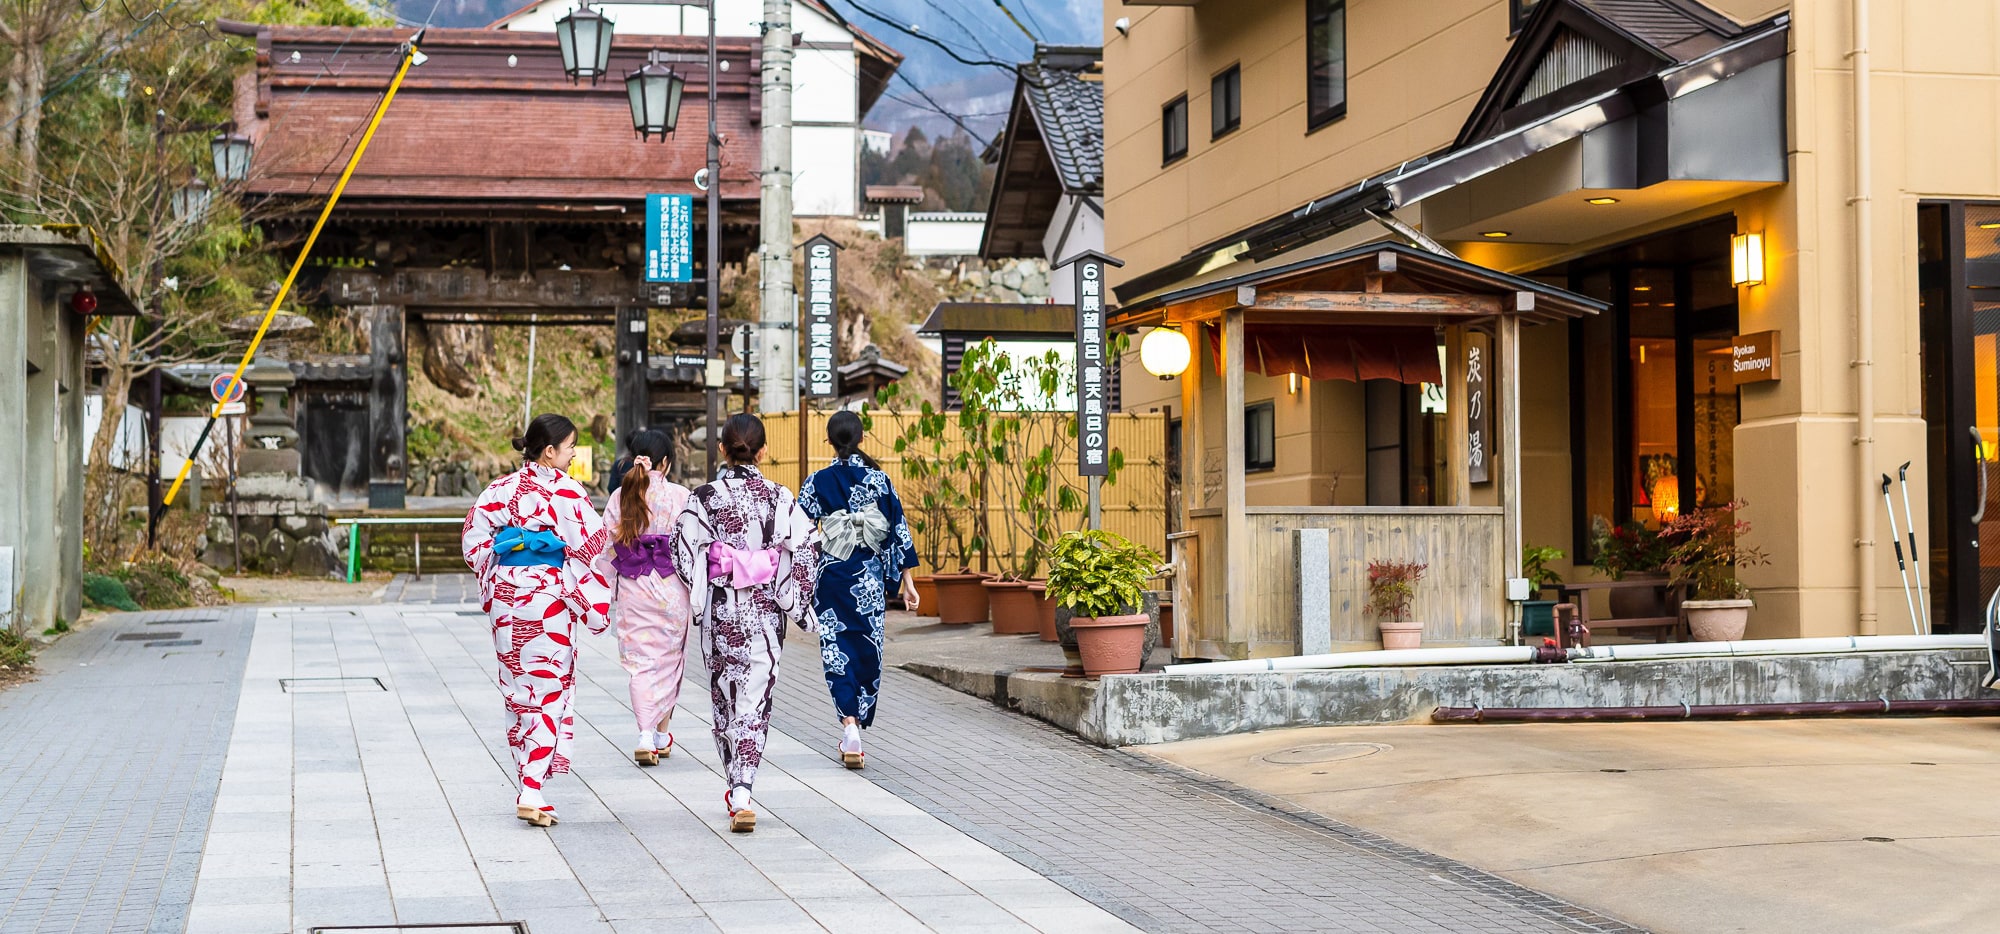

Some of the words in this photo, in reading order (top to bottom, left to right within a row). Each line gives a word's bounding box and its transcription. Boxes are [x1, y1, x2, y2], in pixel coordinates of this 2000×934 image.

[1082, 263, 1103, 465] 6階展望風呂、露天風呂の宿
[1733, 344, 1756, 358] Ryokan
[1733, 356, 1771, 372] Suminoyu
[1466, 347, 1483, 468] 炭乃湯
